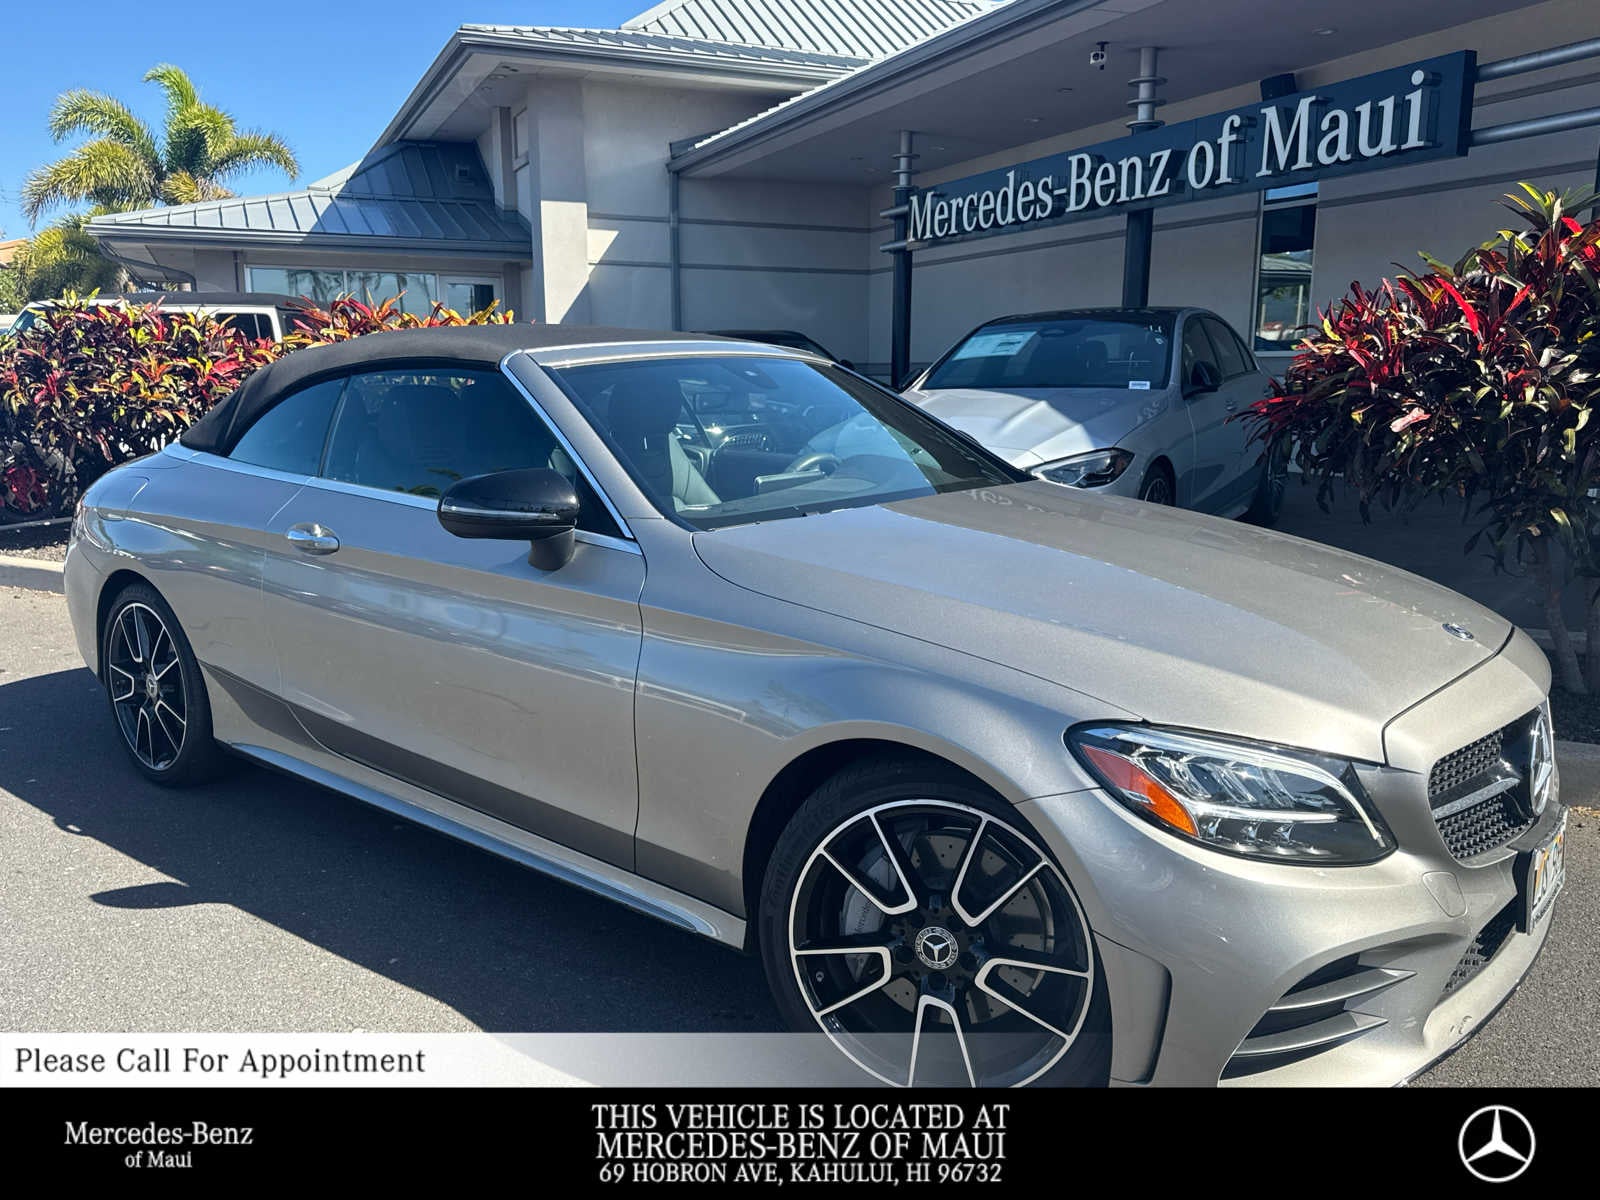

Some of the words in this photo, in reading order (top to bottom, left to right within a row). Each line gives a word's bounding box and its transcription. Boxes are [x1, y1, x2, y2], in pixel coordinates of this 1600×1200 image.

[907, 148, 1172, 242] Mercedes-Benz
[1187, 114, 1242, 190] of
[1256, 69, 1432, 178] Maui
